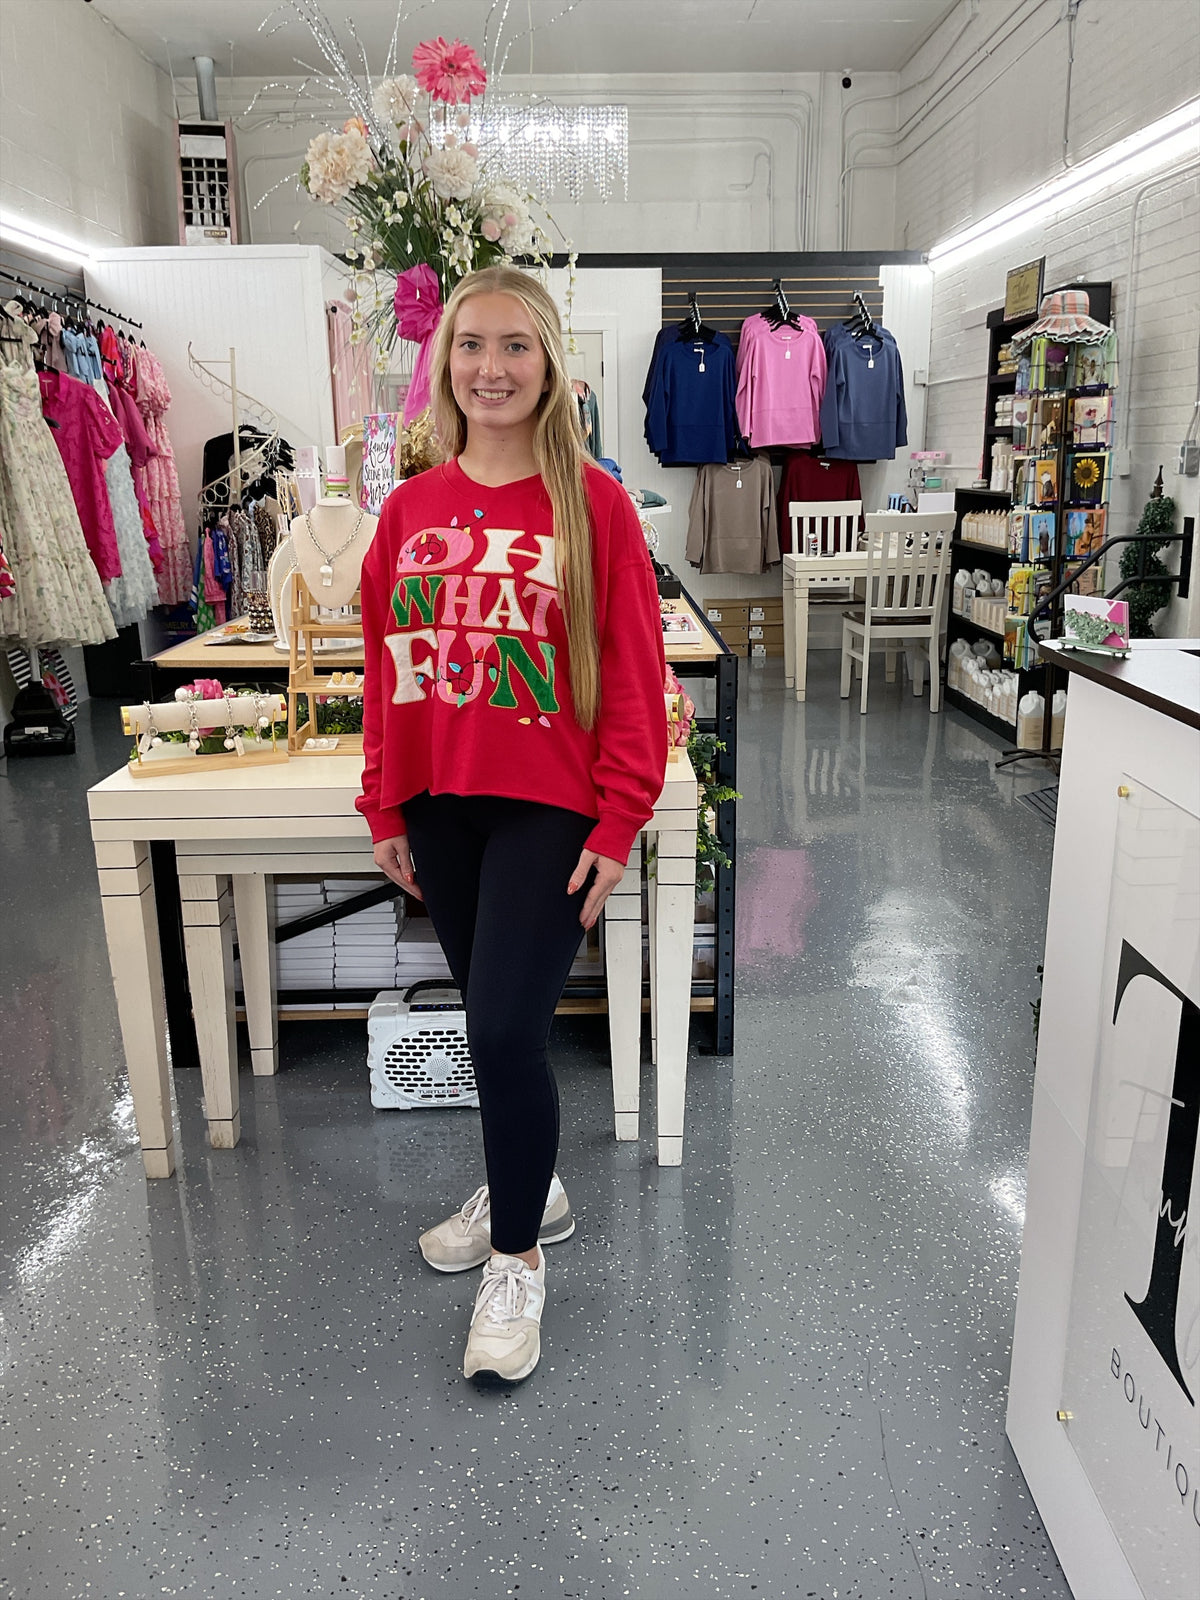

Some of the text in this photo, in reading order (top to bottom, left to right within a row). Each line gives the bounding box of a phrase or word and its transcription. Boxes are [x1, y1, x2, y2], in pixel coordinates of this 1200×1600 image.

[396, 527, 563, 590] OH
[391, 574, 563, 638] WHAT
[384, 628, 561, 714] FUN
